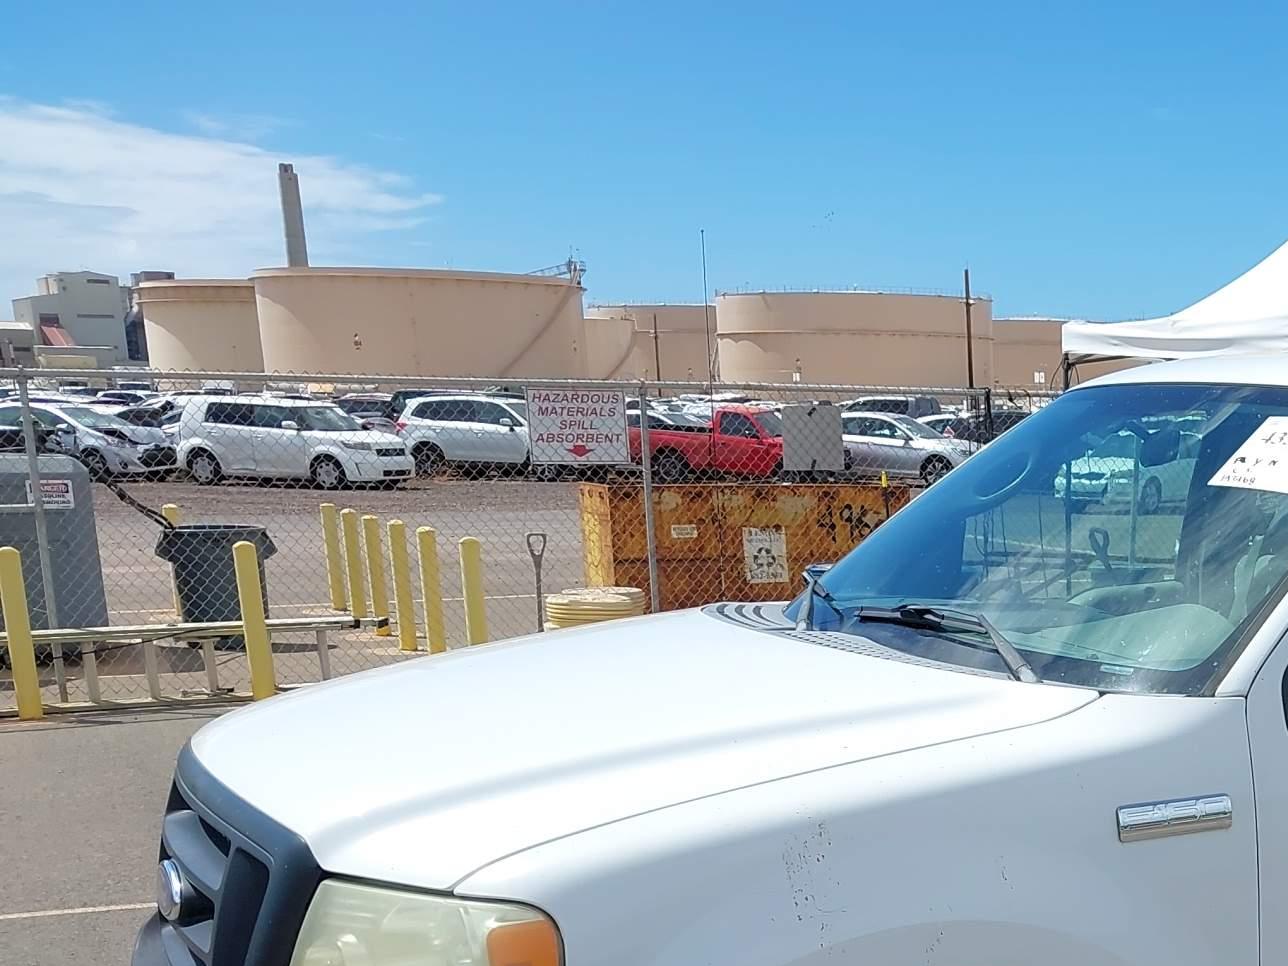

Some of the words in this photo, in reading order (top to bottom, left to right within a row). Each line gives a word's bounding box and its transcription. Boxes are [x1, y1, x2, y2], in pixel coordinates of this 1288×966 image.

[531, 392, 620, 404] HAZARDOUS
[537, 406, 616, 417] MATERIALS
[559, 420, 599, 430] SPILL
[535, 432, 622, 443] ABSORBENT
